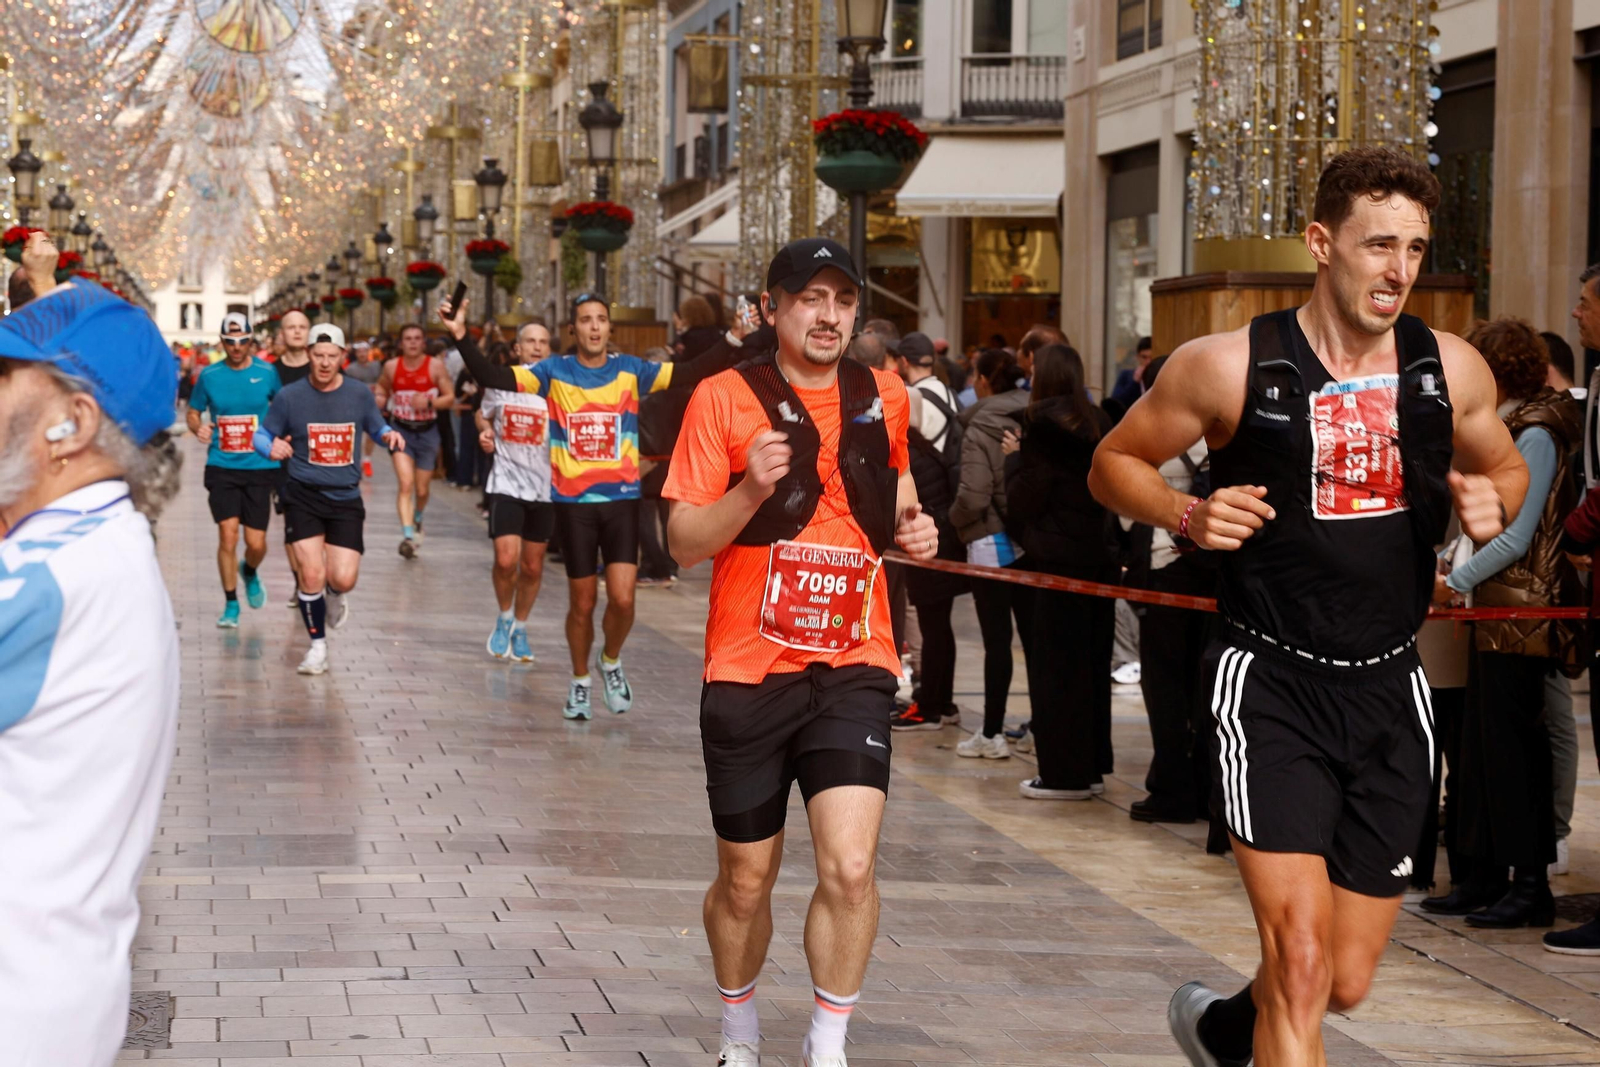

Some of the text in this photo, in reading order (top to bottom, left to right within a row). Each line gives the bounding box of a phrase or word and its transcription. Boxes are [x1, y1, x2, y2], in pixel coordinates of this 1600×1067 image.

[1344, 420, 1369, 484] 5313
[802, 548, 865, 568] GENERALI
[796, 569, 848, 596] 7096
[808, 595, 830, 604] ADAM
